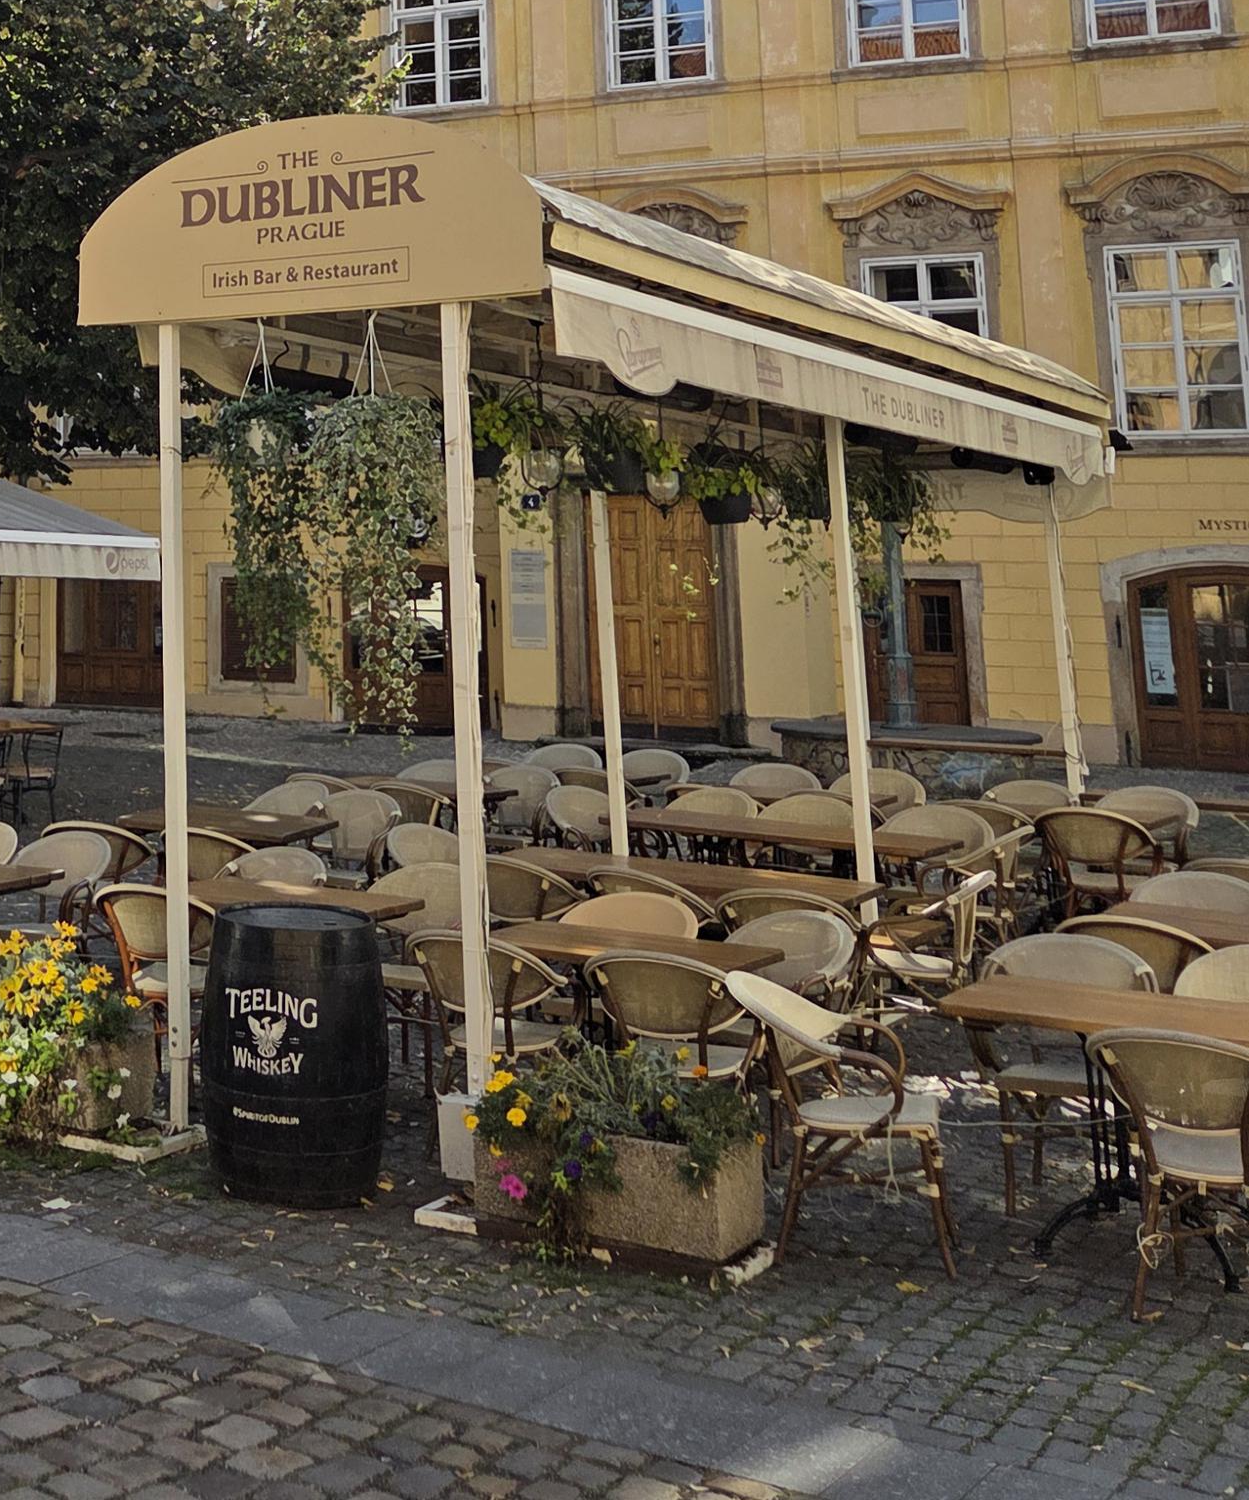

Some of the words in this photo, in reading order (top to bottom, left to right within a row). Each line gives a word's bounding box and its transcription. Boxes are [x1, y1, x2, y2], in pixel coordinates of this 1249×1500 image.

[277, 149, 319, 170] THE
[180, 163, 427, 228] DUBLINER
[257, 220, 345, 245] PRAGUE
[213, 270, 249, 289] Irish
[253, 269, 282, 285] Bar
[286, 266, 299, 283] &
[303, 258, 399, 282] Restaurant
[862, 386, 887, 416] THE
[890, 396, 946, 430] DUBLINER
[1198, 519, 1249, 531] MYSTI
[225, 987, 318, 1029] TEELING
[232, 1045, 304, 1075] WHISKEY
